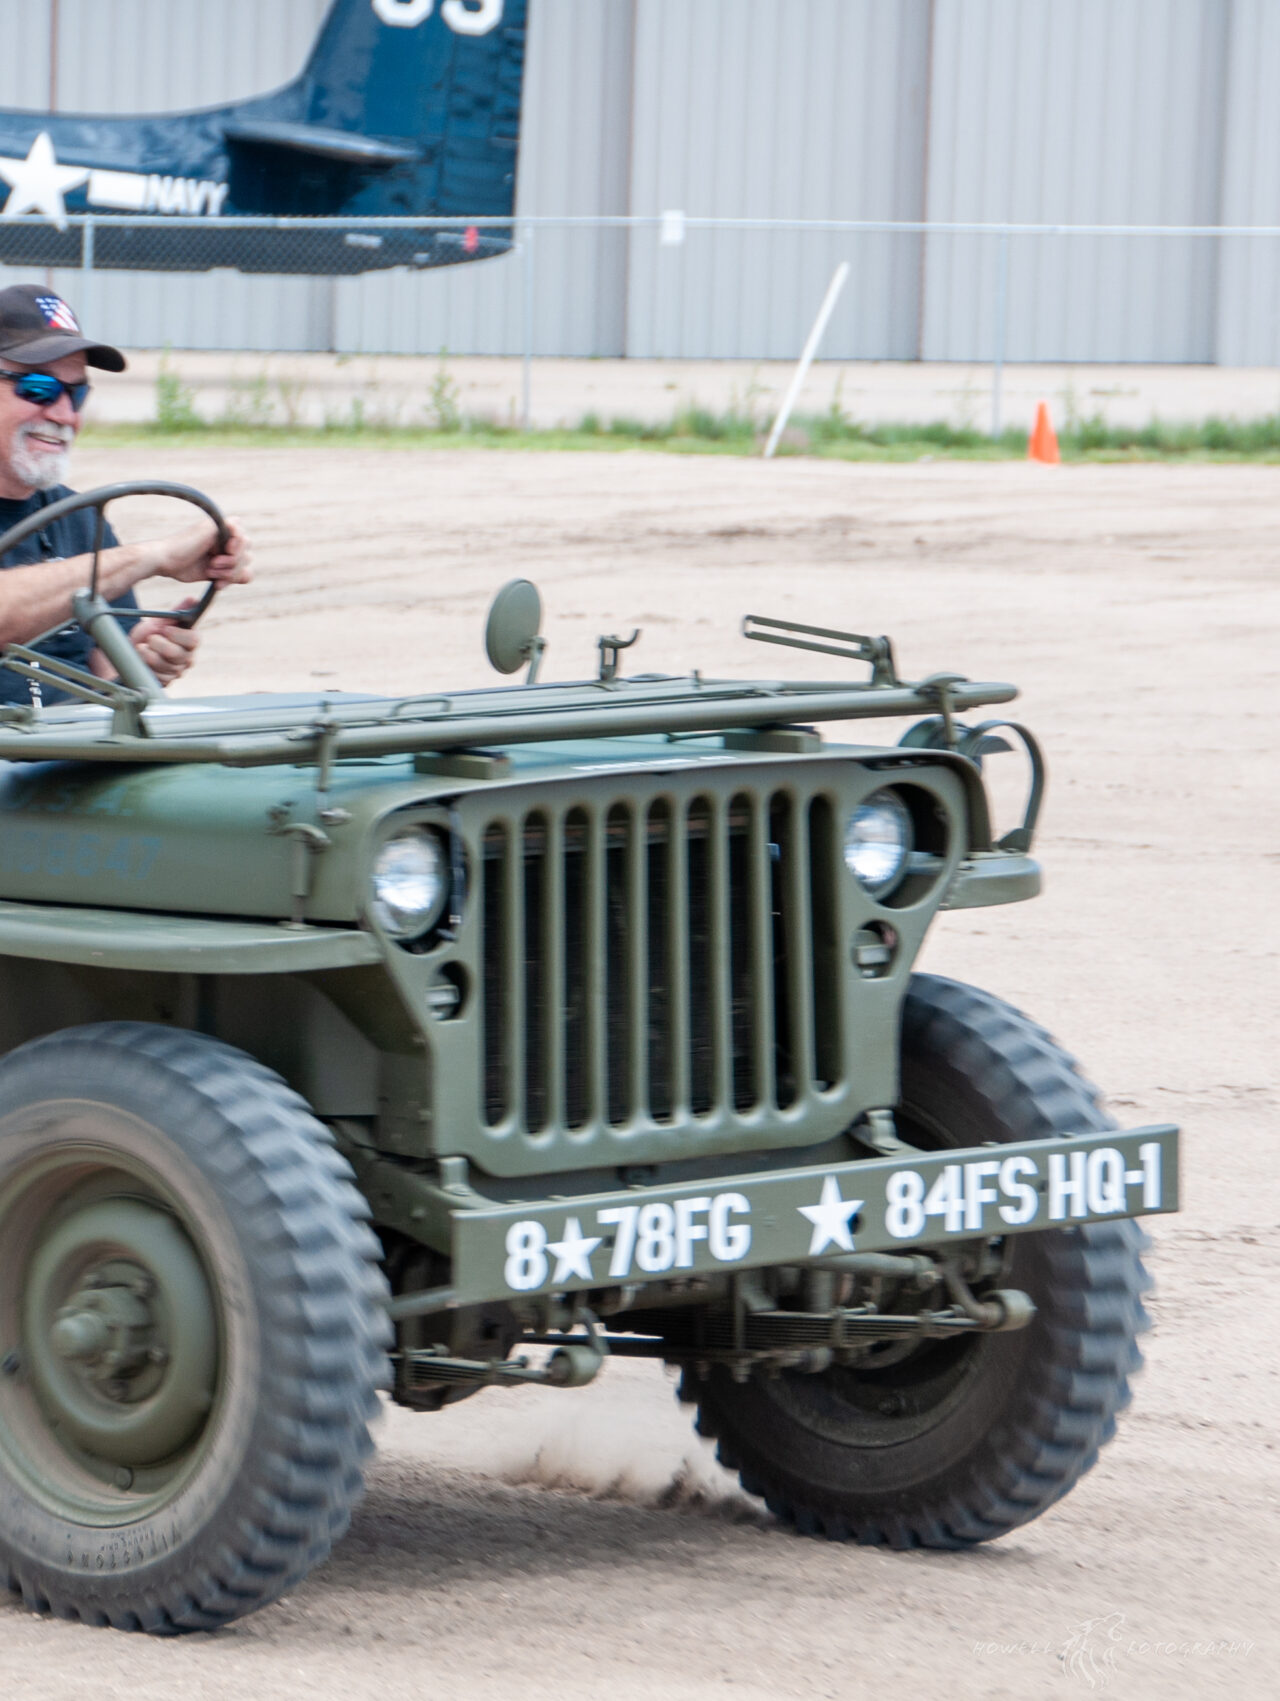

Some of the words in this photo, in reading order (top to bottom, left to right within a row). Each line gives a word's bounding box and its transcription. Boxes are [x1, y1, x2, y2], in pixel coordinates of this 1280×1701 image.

[147, 174, 229, 216] NAVY
[885, 1153, 1038, 1239] 84FS
[1047, 1142, 1162, 1220] HQ-1
